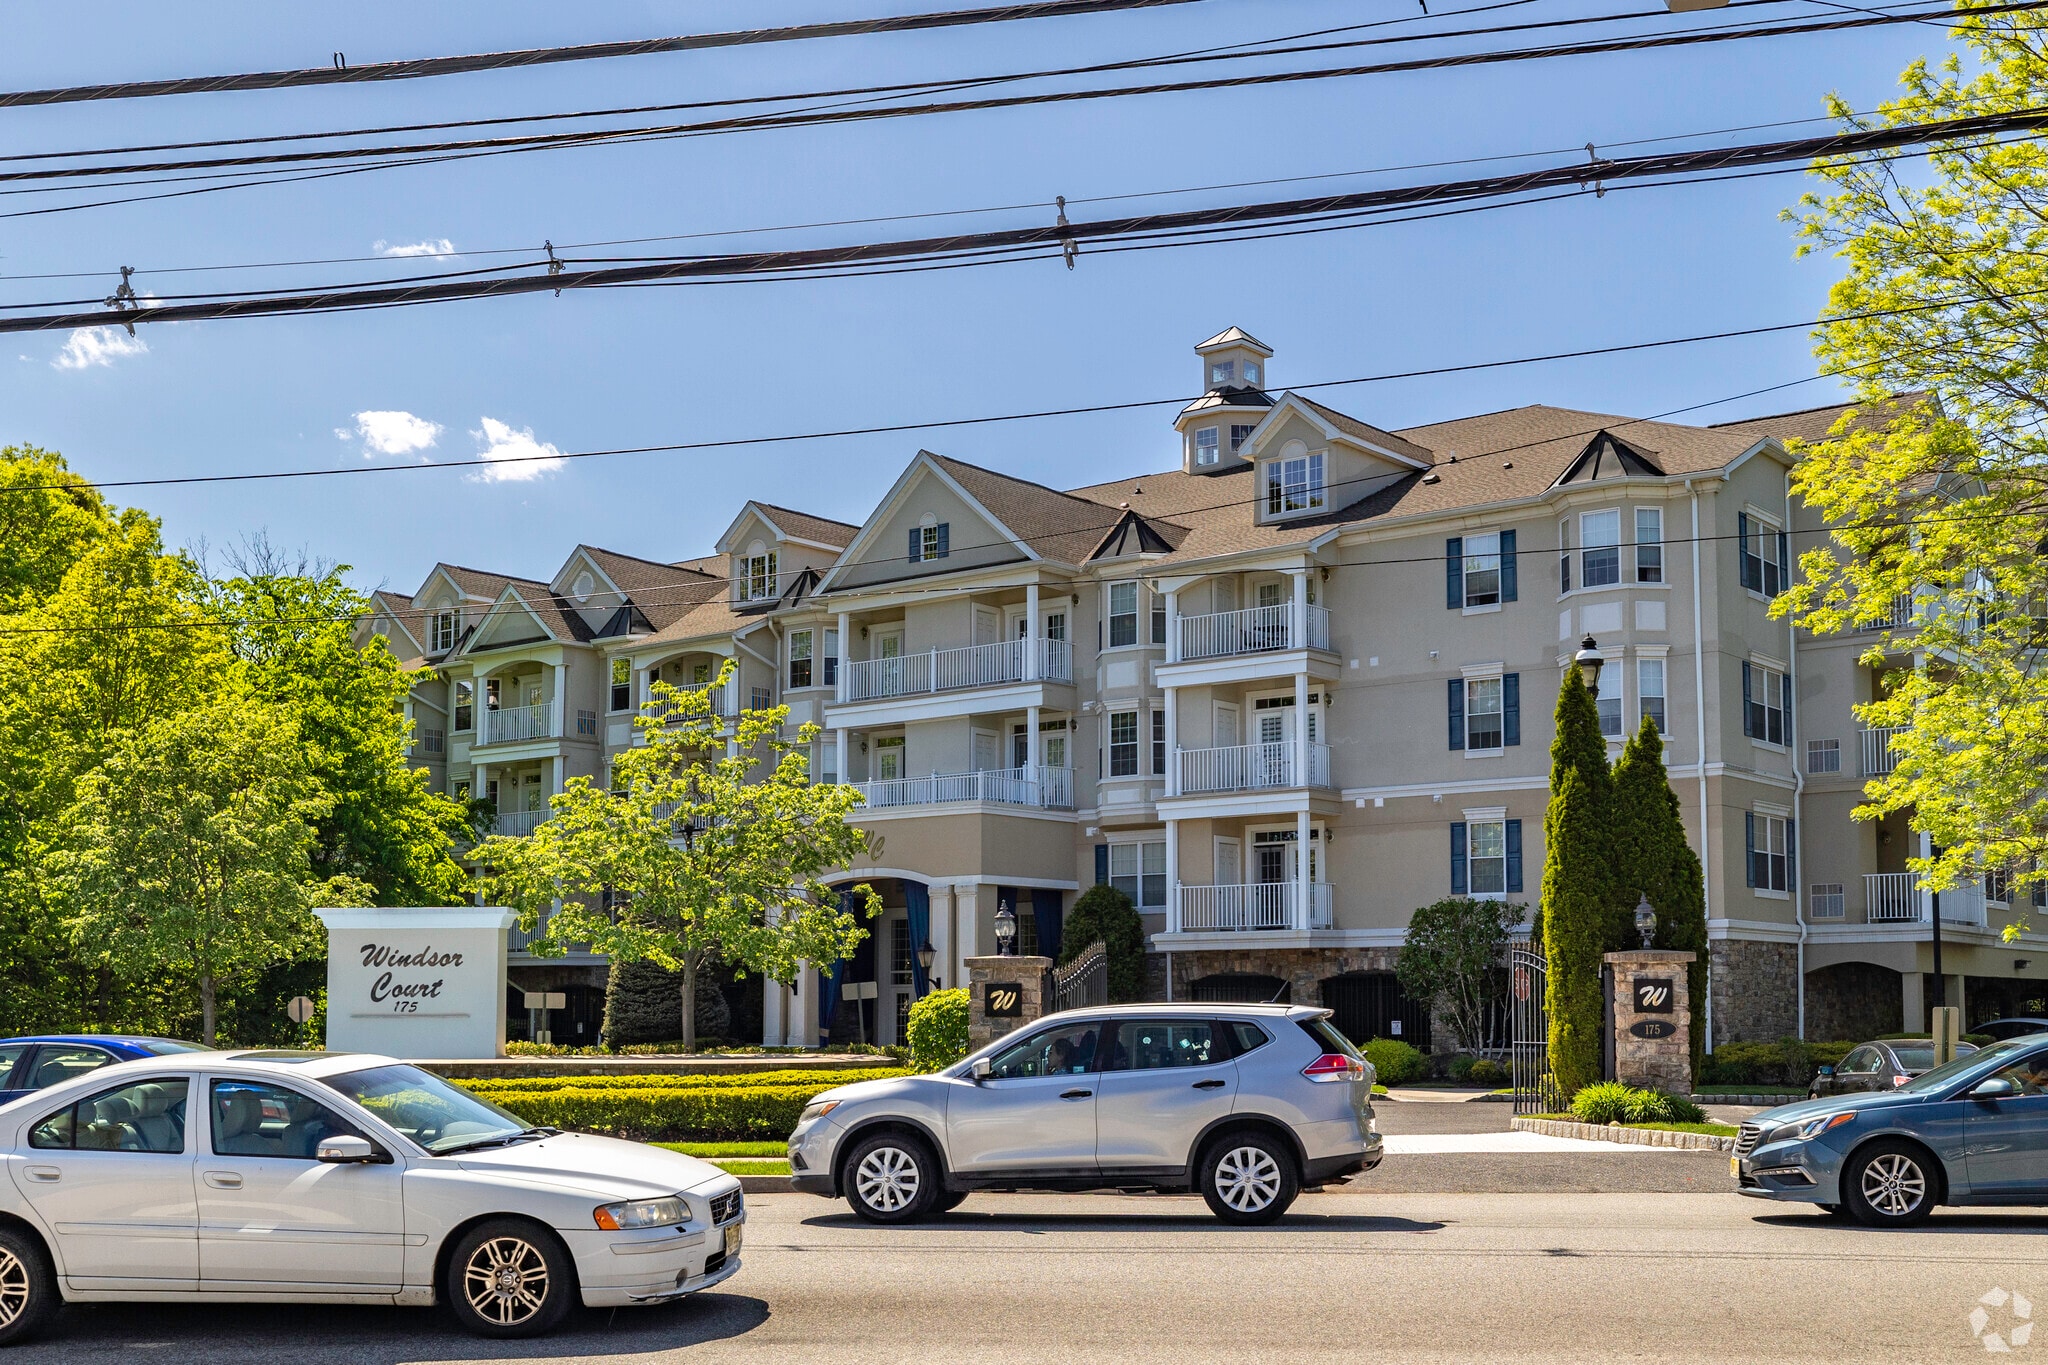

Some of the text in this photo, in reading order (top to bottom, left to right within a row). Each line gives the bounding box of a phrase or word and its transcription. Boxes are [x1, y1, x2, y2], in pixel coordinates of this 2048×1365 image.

[360, 943, 463, 968] Windsor
[370, 971, 444, 1003] Court
[1639, 985, 1668, 1007] W
[393, 1001, 418, 1013] 175
[990, 989, 1017, 1011] W
[1645, 1024, 1661, 1035] 175
